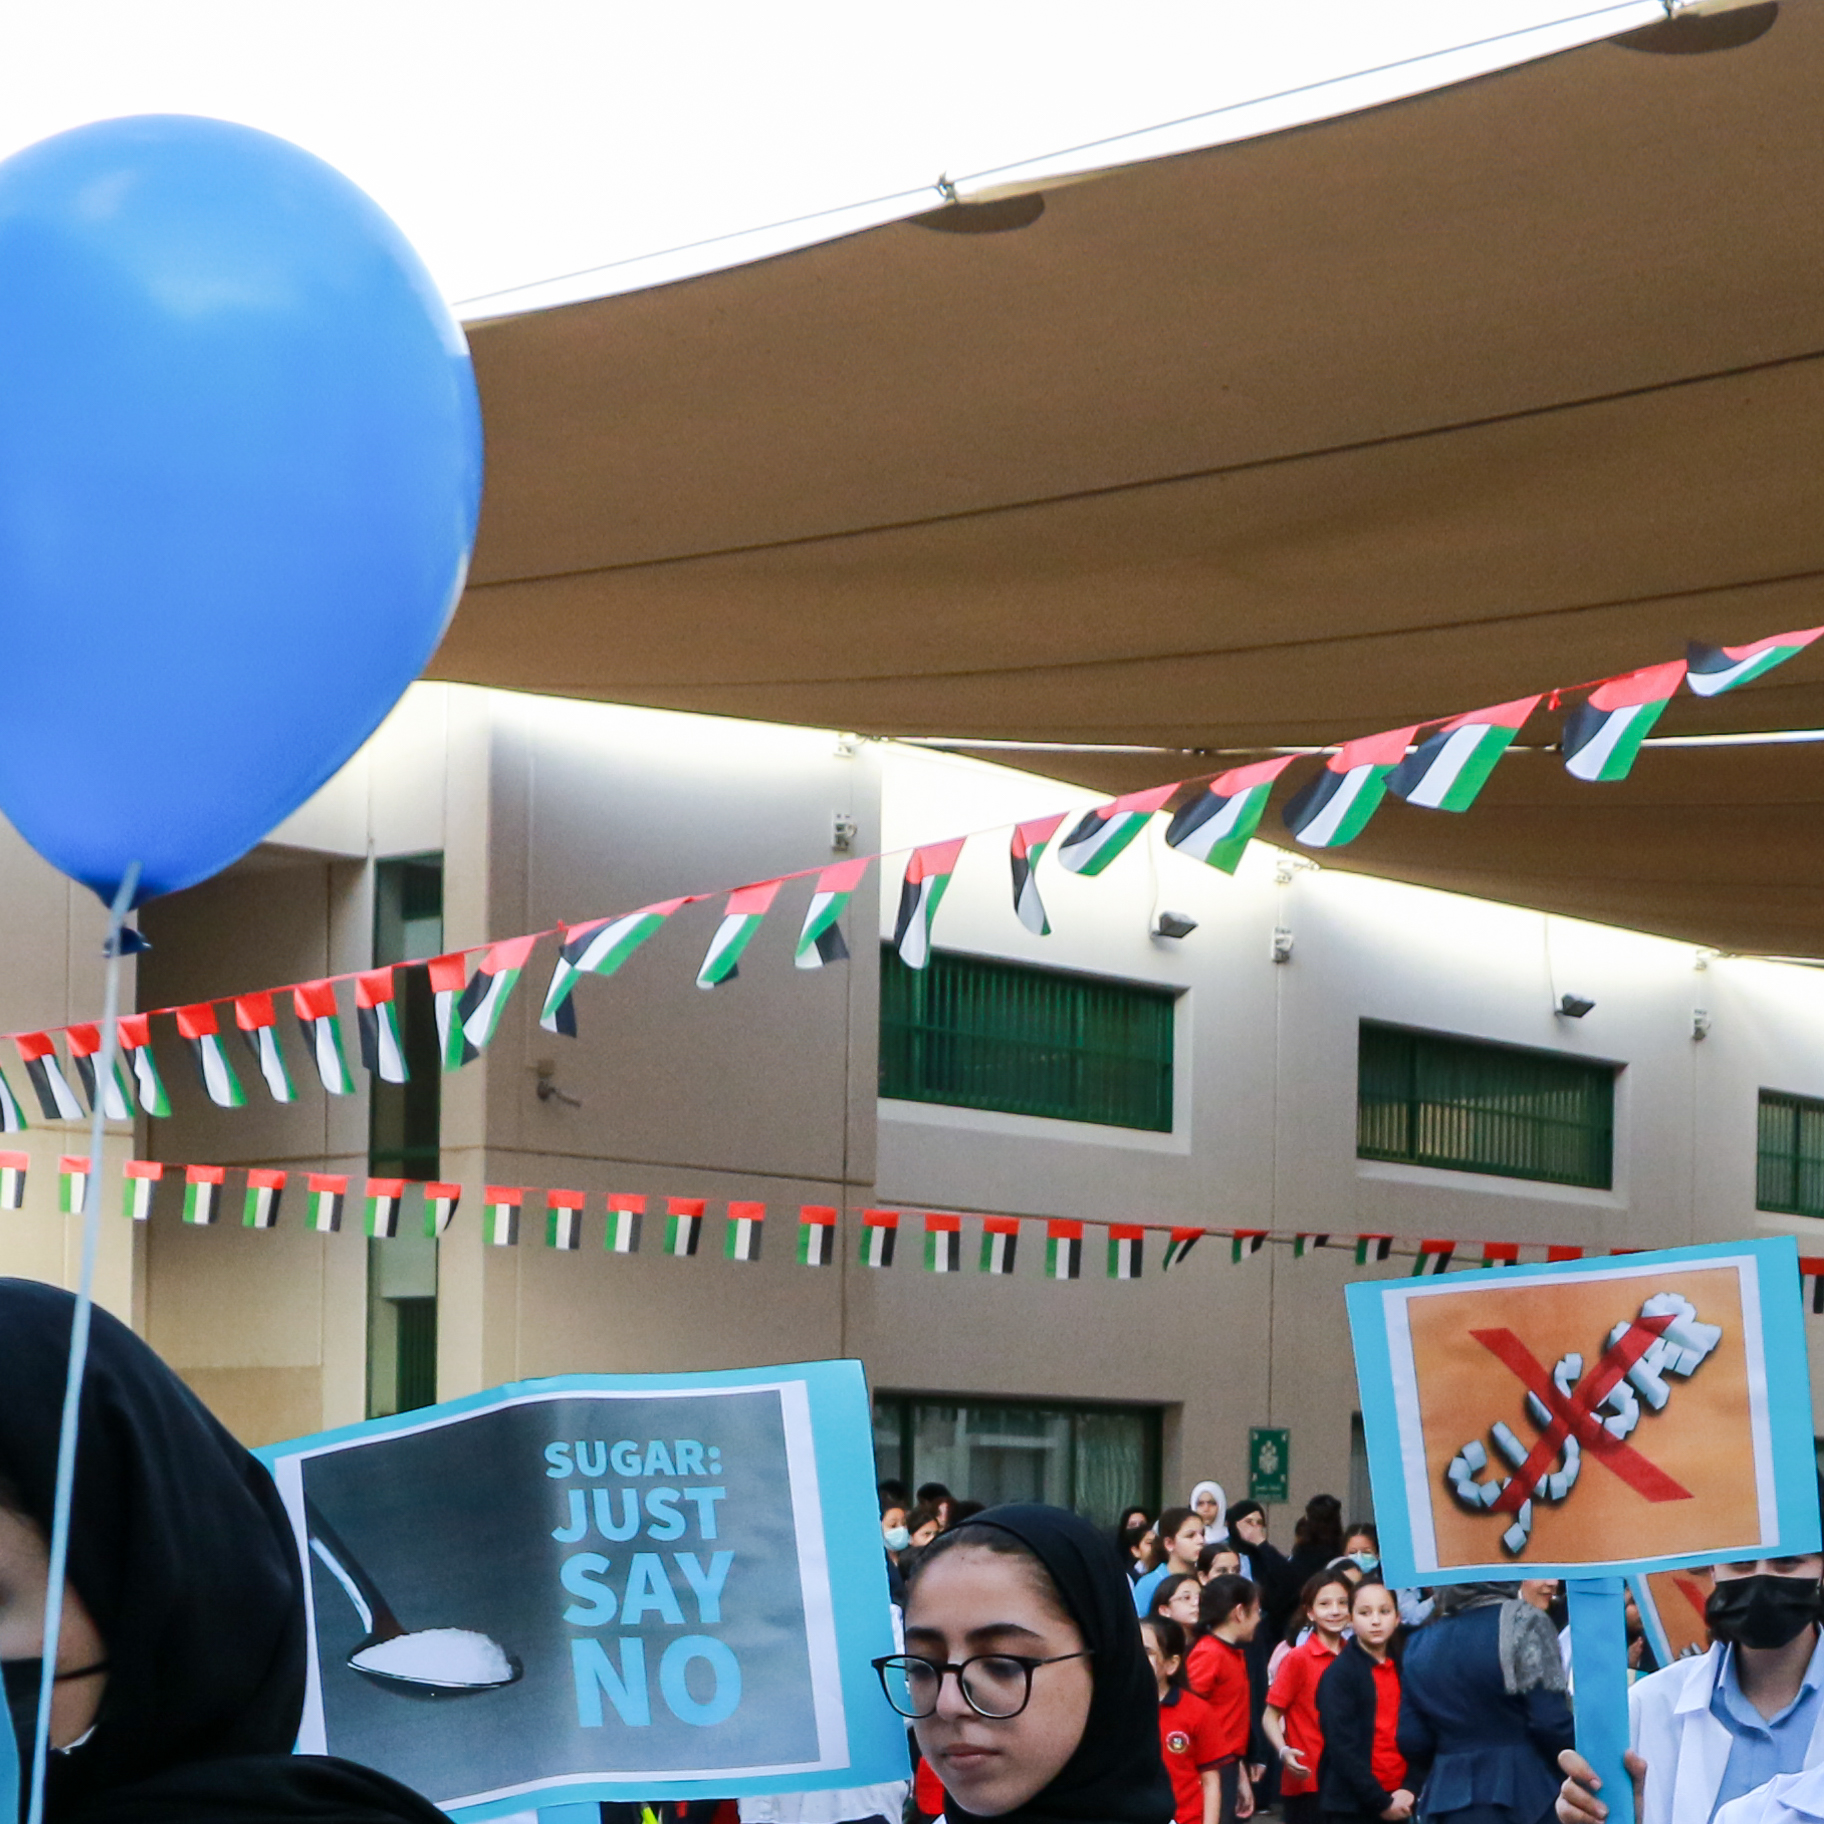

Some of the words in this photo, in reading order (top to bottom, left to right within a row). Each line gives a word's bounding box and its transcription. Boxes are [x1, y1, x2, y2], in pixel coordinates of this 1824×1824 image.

[543, 1438, 723, 1480] SUGAR:
[550, 1486, 727, 1544] JUST
[559, 1550, 735, 1628] SAY
[569, 1633, 743, 1730] NO
